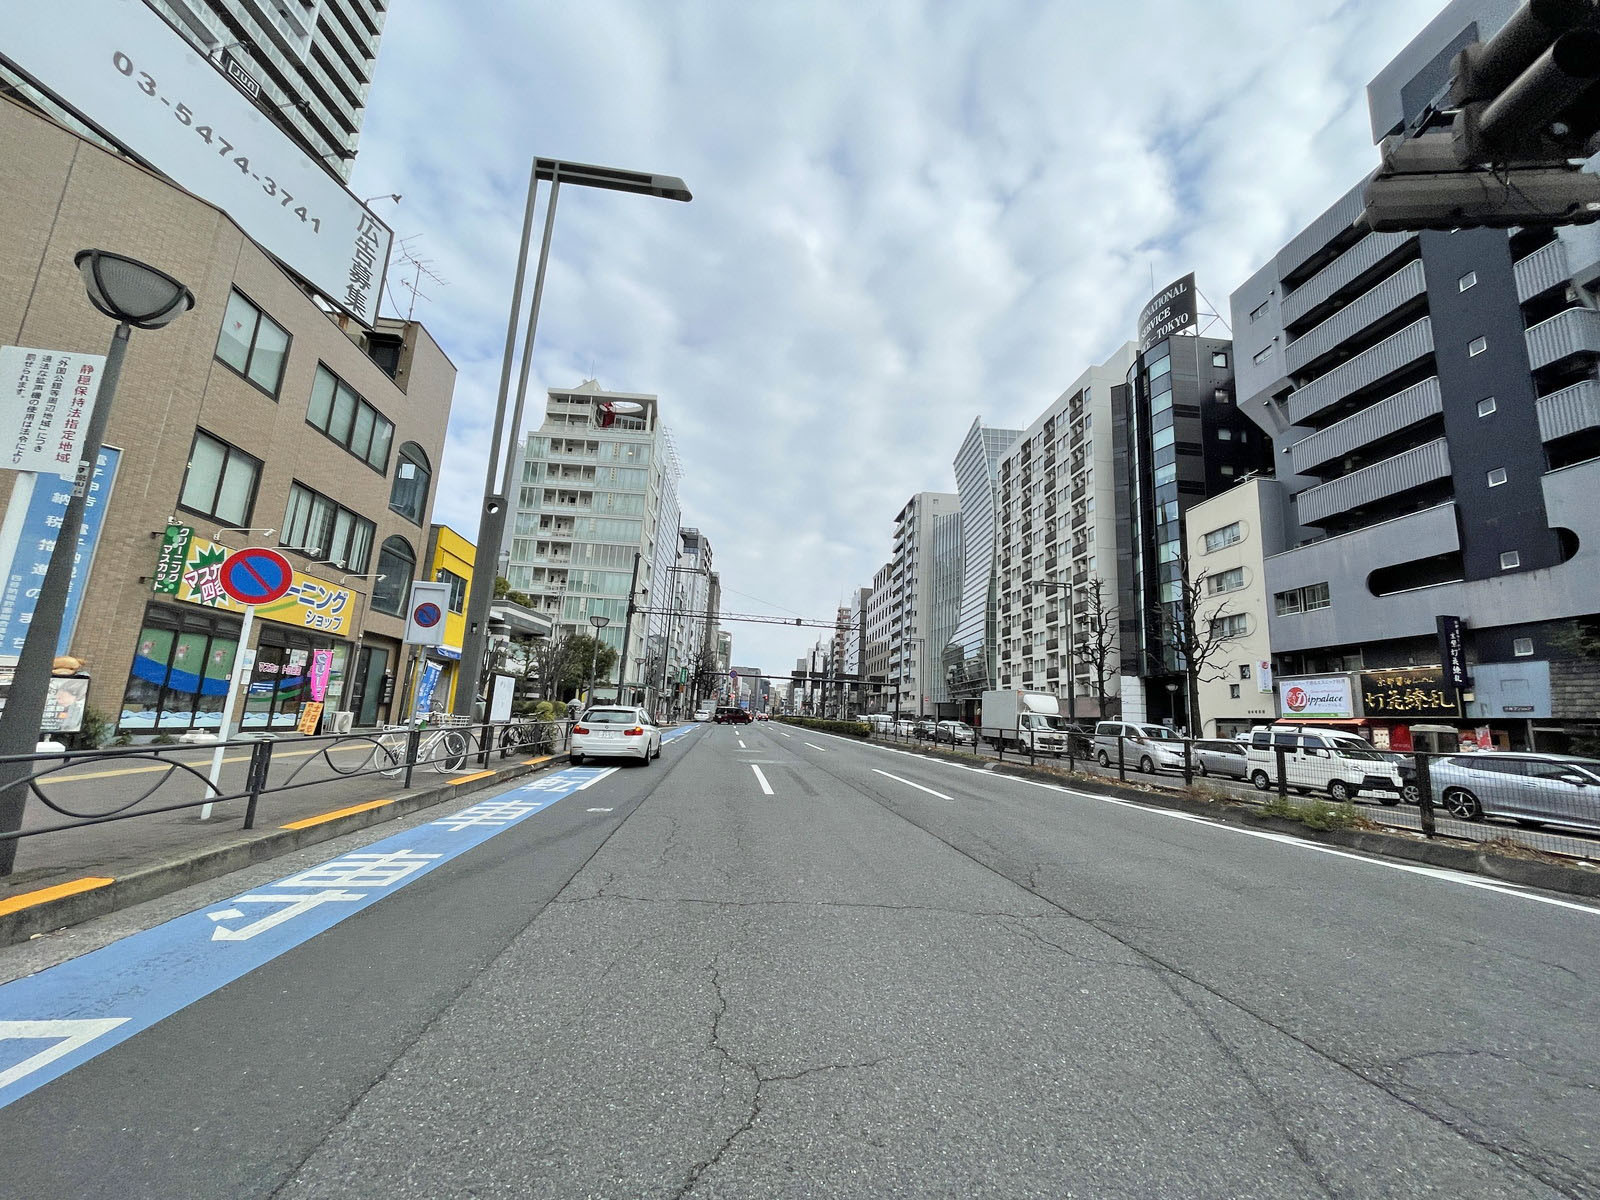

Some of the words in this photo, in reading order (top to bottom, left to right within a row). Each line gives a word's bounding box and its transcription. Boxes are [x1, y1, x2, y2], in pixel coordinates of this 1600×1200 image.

[113, 50, 321, 235] 03-5474-3741
[343, 211, 383, 318] 広告募集
[153, 544, 173, 591] マスカット
[168, 528, 190, 582] クリーニング
[305, 610, 343, 632] ショップ
[1295, 691, 1344, 706] Dippalace
